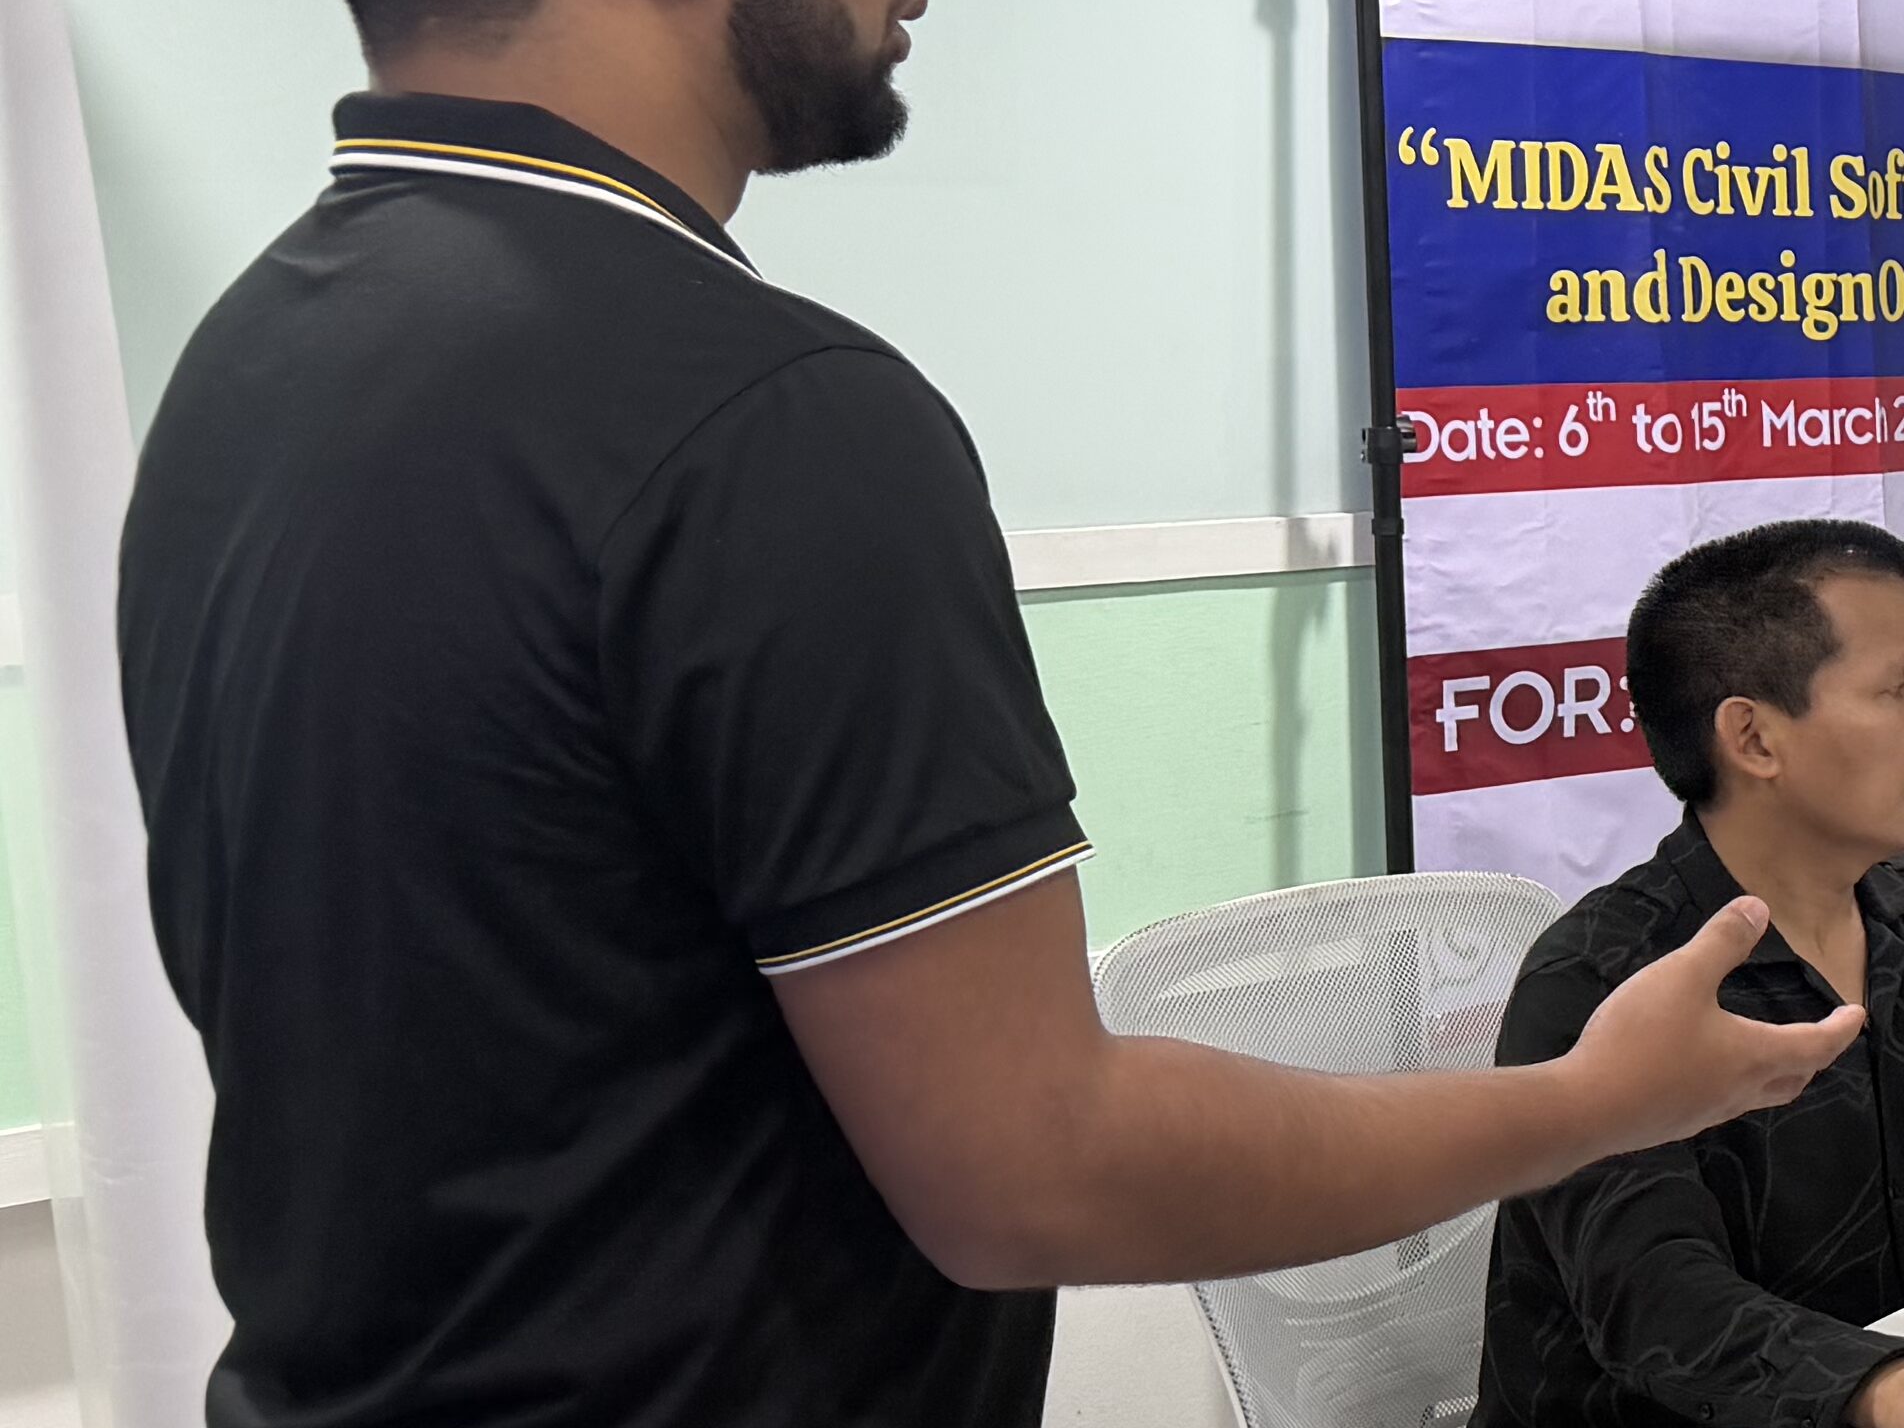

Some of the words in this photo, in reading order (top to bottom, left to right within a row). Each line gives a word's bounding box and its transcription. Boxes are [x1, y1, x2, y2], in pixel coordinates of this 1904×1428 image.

[1683, 141, 1814, 218] Civil
[1546, 248, 1672, 323] and
[1404, 409, 1544, 463] Date:
[1558, 390, 1616, 457] 6th
[1632, 404, 1682, 453] to
[1691, 387, 1748, 451] 15th
[1761, 395, 1888, 447] March
[1435, 665, 1635, 752] FOR:
